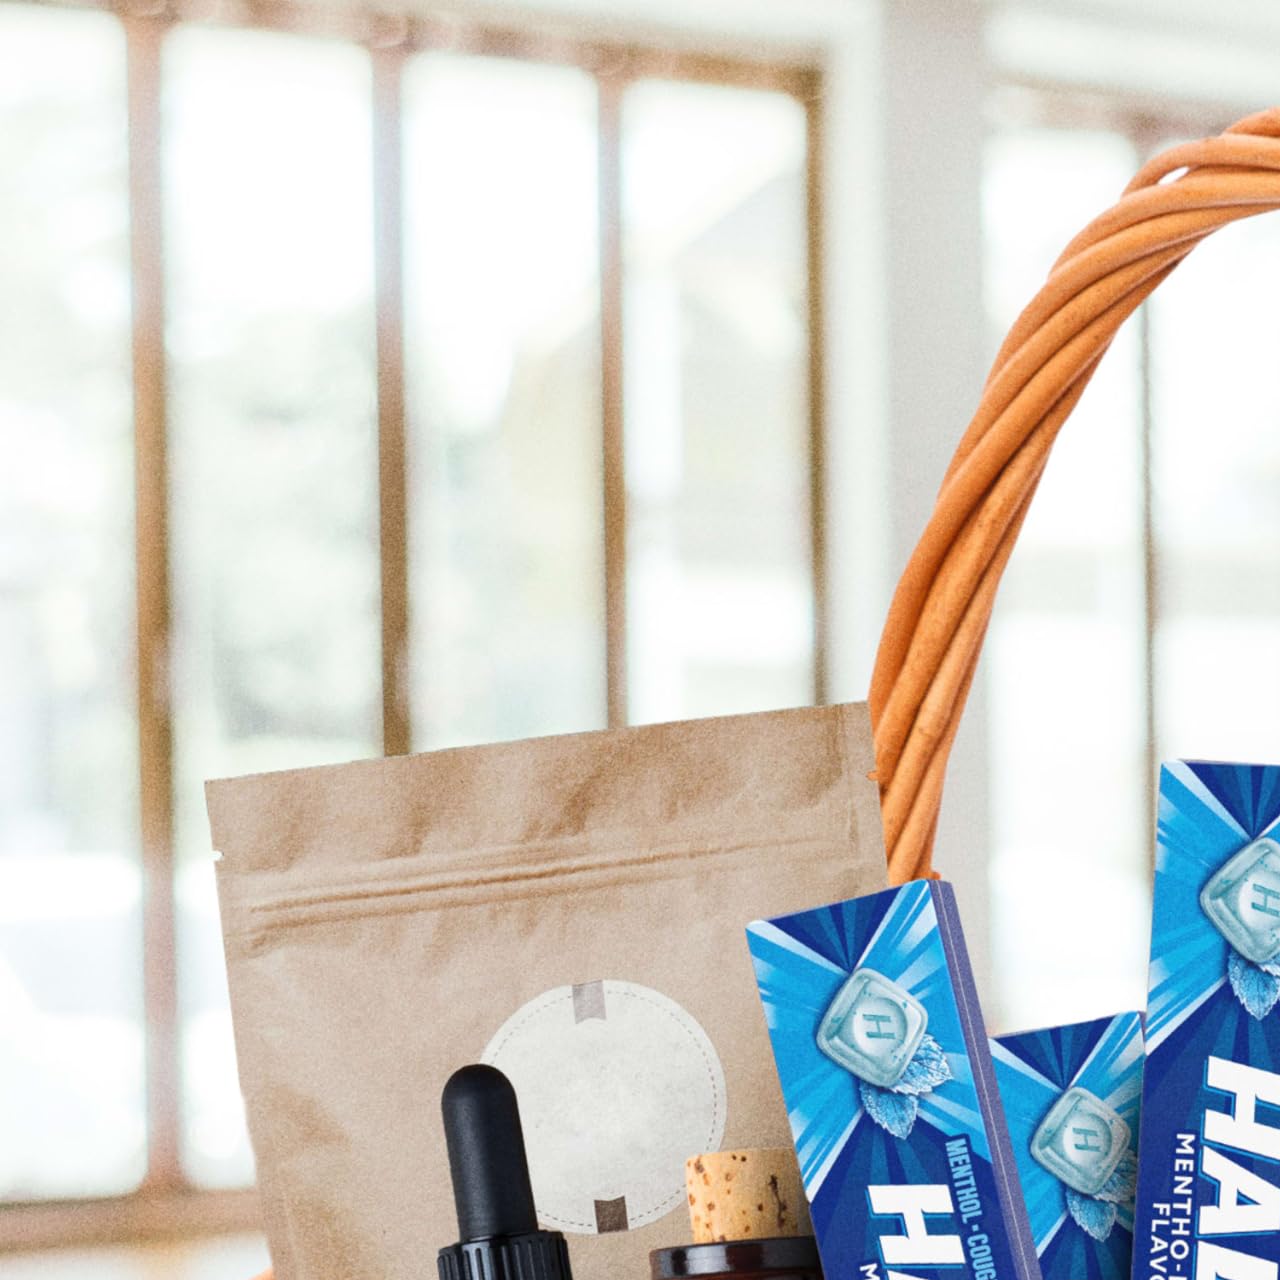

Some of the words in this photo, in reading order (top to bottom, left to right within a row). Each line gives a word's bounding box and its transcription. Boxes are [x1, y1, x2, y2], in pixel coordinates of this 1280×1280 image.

[1251, 883, 1280, 918] H
[862, 1013, 897, 1040] H
[1072, 1126, 1102, 1153] H
[945, 1137, 983, 1225] MENTHOL
